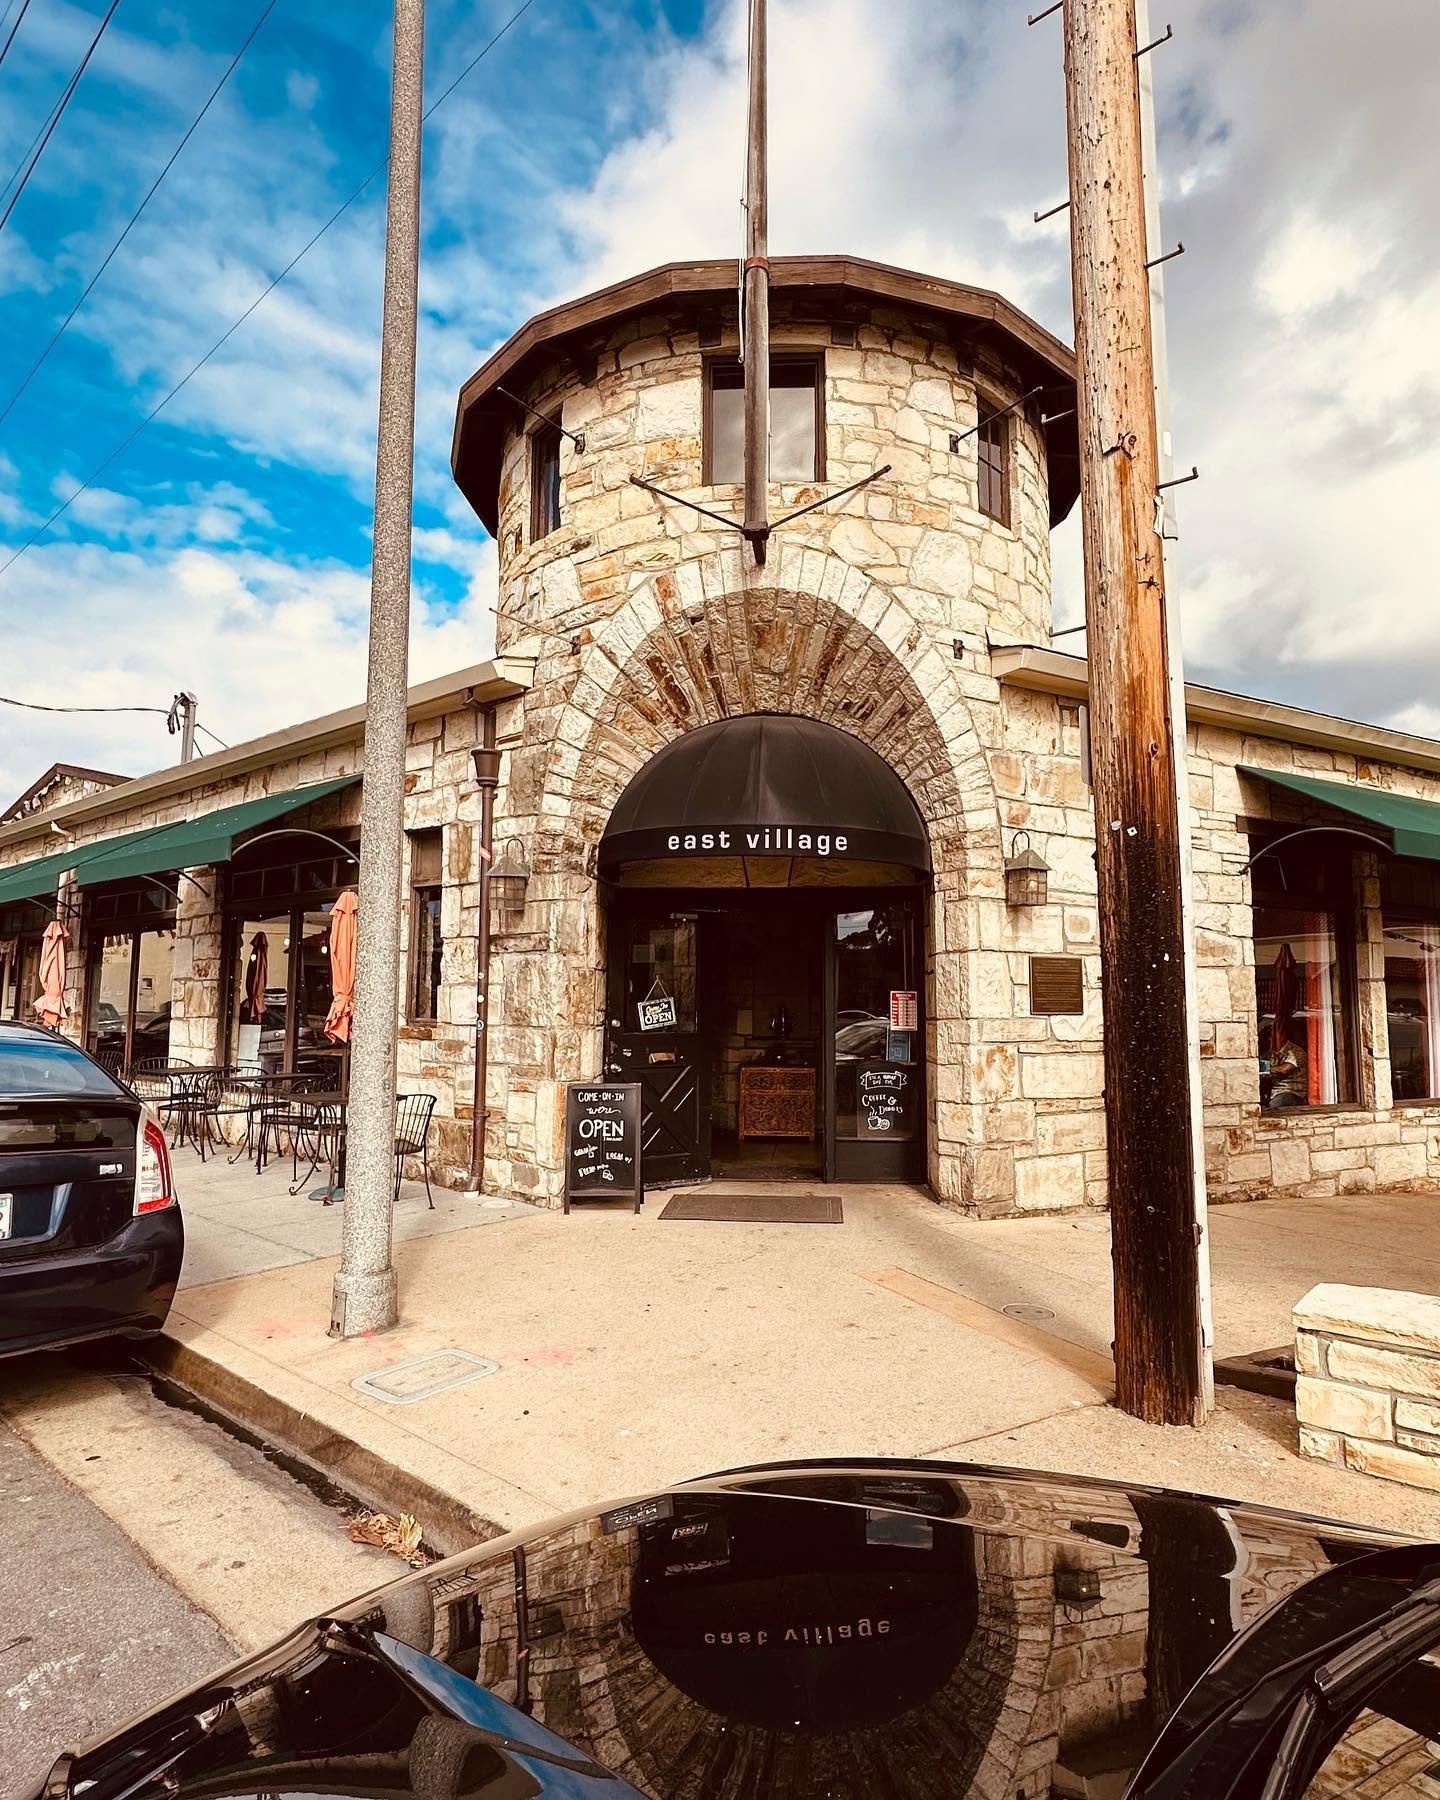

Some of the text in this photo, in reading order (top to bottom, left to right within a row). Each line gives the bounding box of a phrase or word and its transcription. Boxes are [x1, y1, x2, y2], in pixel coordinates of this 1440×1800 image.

[668, 828, 848, 856] east village
[644, 1011, 673, 1025] OPEN
[888, 1096, 897, 1105] &
[579, 1119, 624, 1137] OPEN
